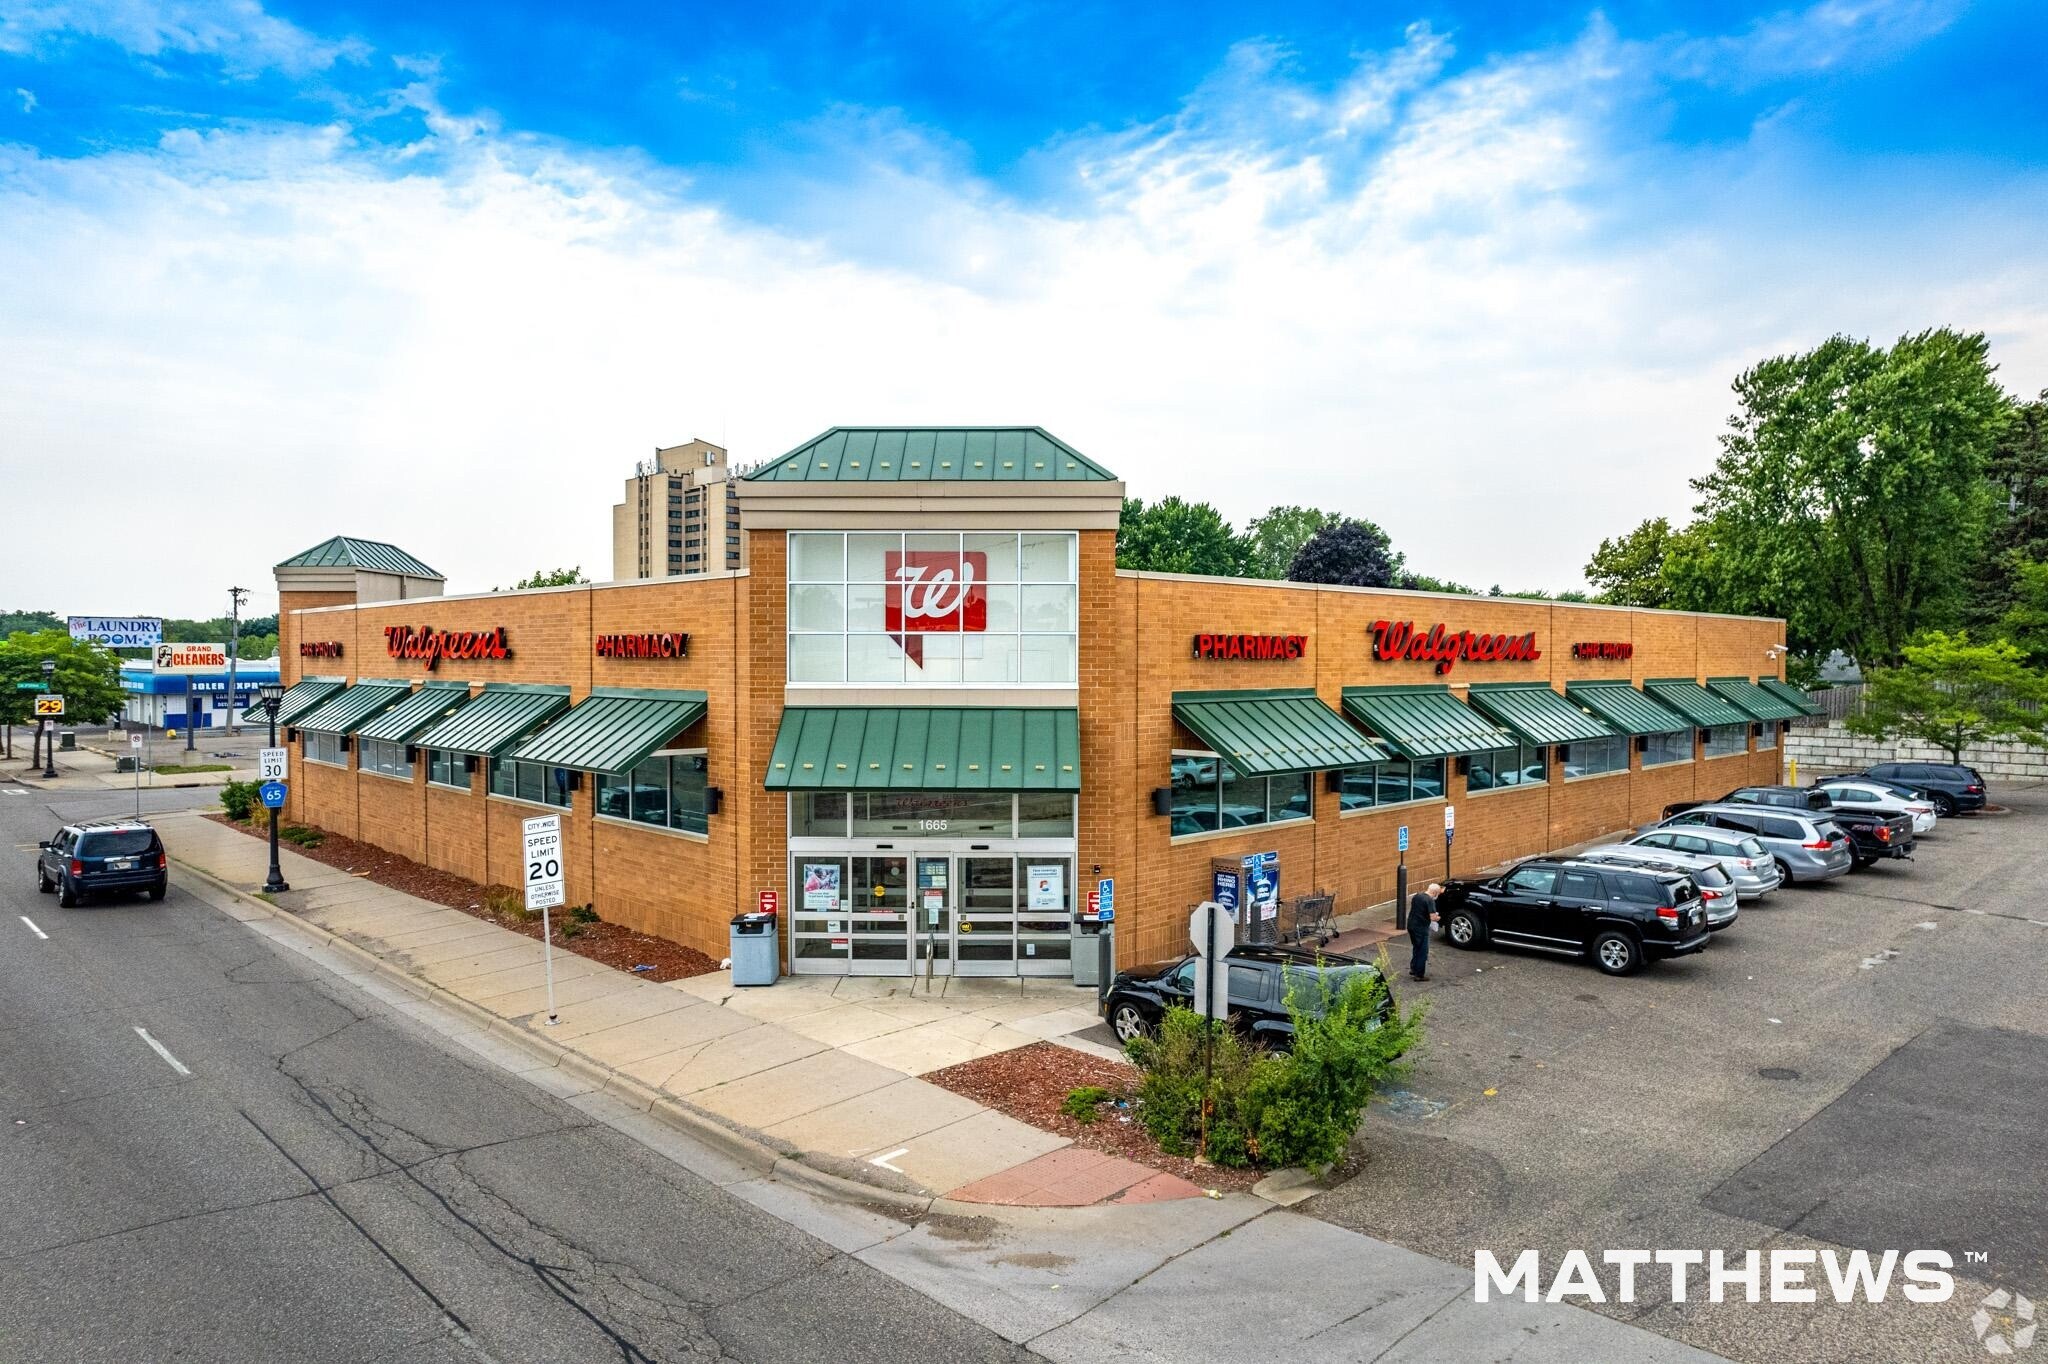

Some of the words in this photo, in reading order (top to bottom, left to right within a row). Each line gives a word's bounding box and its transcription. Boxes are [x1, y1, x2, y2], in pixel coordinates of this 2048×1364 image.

[71, 620, 87, 630] The
[87, 620, 160, 632] LAUNDRY
[384, 626, 508, 671] Walgreens
[595, 633, 686, 657] PHARMACY
[1197, 634, 1309, 659] PHARMACY
[1371, 620, 1542, 675] Walgreens
[1603, 641, 1634, 659] PHOTO
[173, 653, 225, 666] CLEANERS
[38, 700, 62, 713] 29
[265, 765, 282, 777] 30
[266, 790, 282, 800] 65
[527, 822, 540, 831] CITY
[918, 819, 948, 830] 1665
[527, 835, 558, 847] SPEED
[531, 847, 555, 859] LIMIT
[529, 859, 559, 881] 20
[534, 883, 556, 892] UNLESS
[530, 889, 560, 900] OTHERWISE
[535, 897, 556, 906] POSTED
